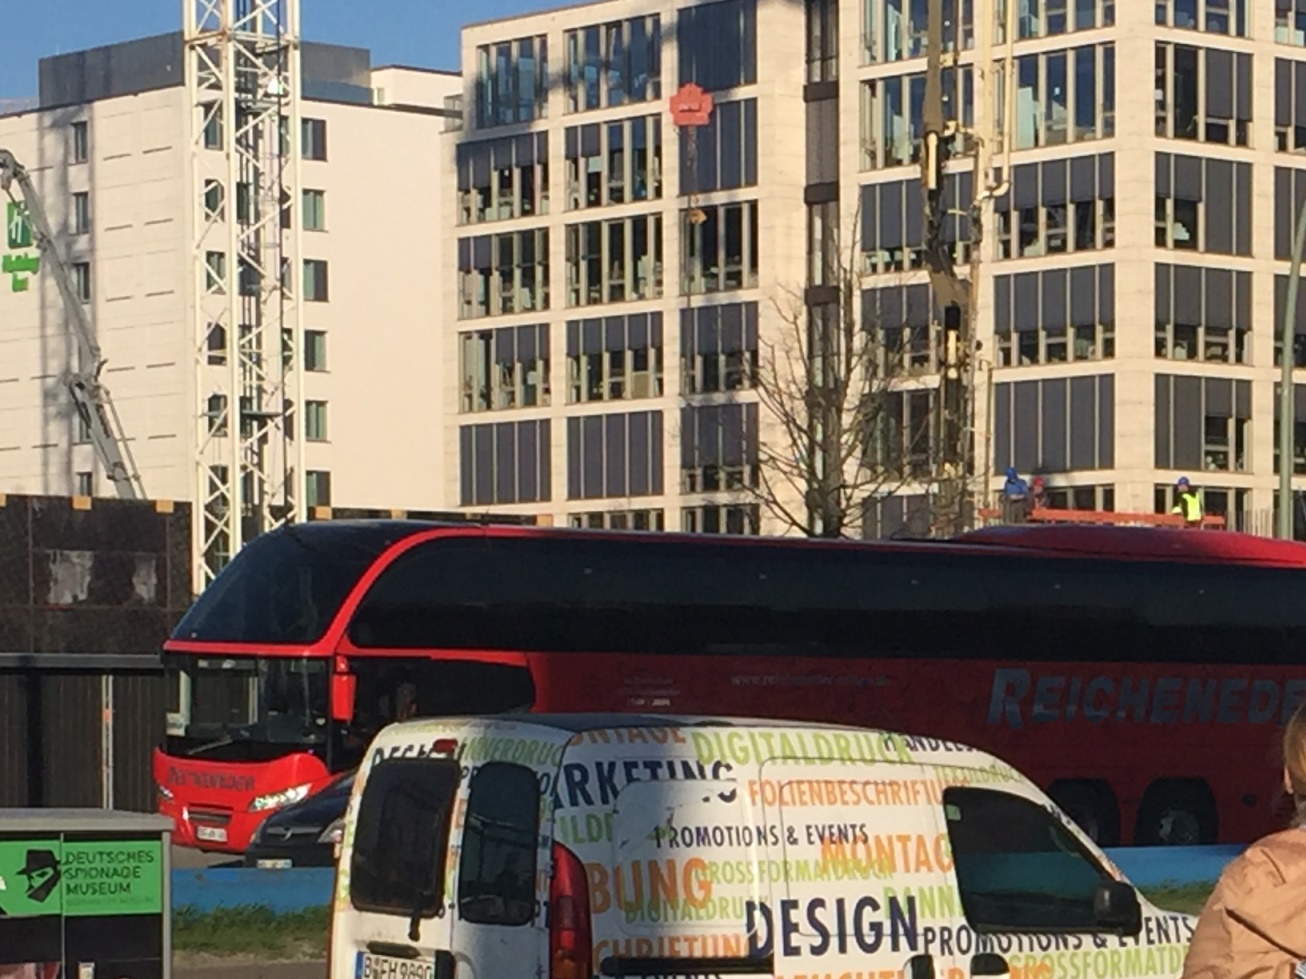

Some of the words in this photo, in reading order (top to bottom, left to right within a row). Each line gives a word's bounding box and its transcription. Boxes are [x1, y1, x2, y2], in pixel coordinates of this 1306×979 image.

[748, 778, 970, 807] FOLIENBESCHRIFTU
[786, 826, 798, 845] &
[806, 823, 869, 845] EVENTS
[64, 851, 154, 866] DEUTSCHES
[64, 866, 141, 880] SPIONAGE
[66, 882, 131, 896] MUSEUM
[745, 895, 919, 959] DESIGN
